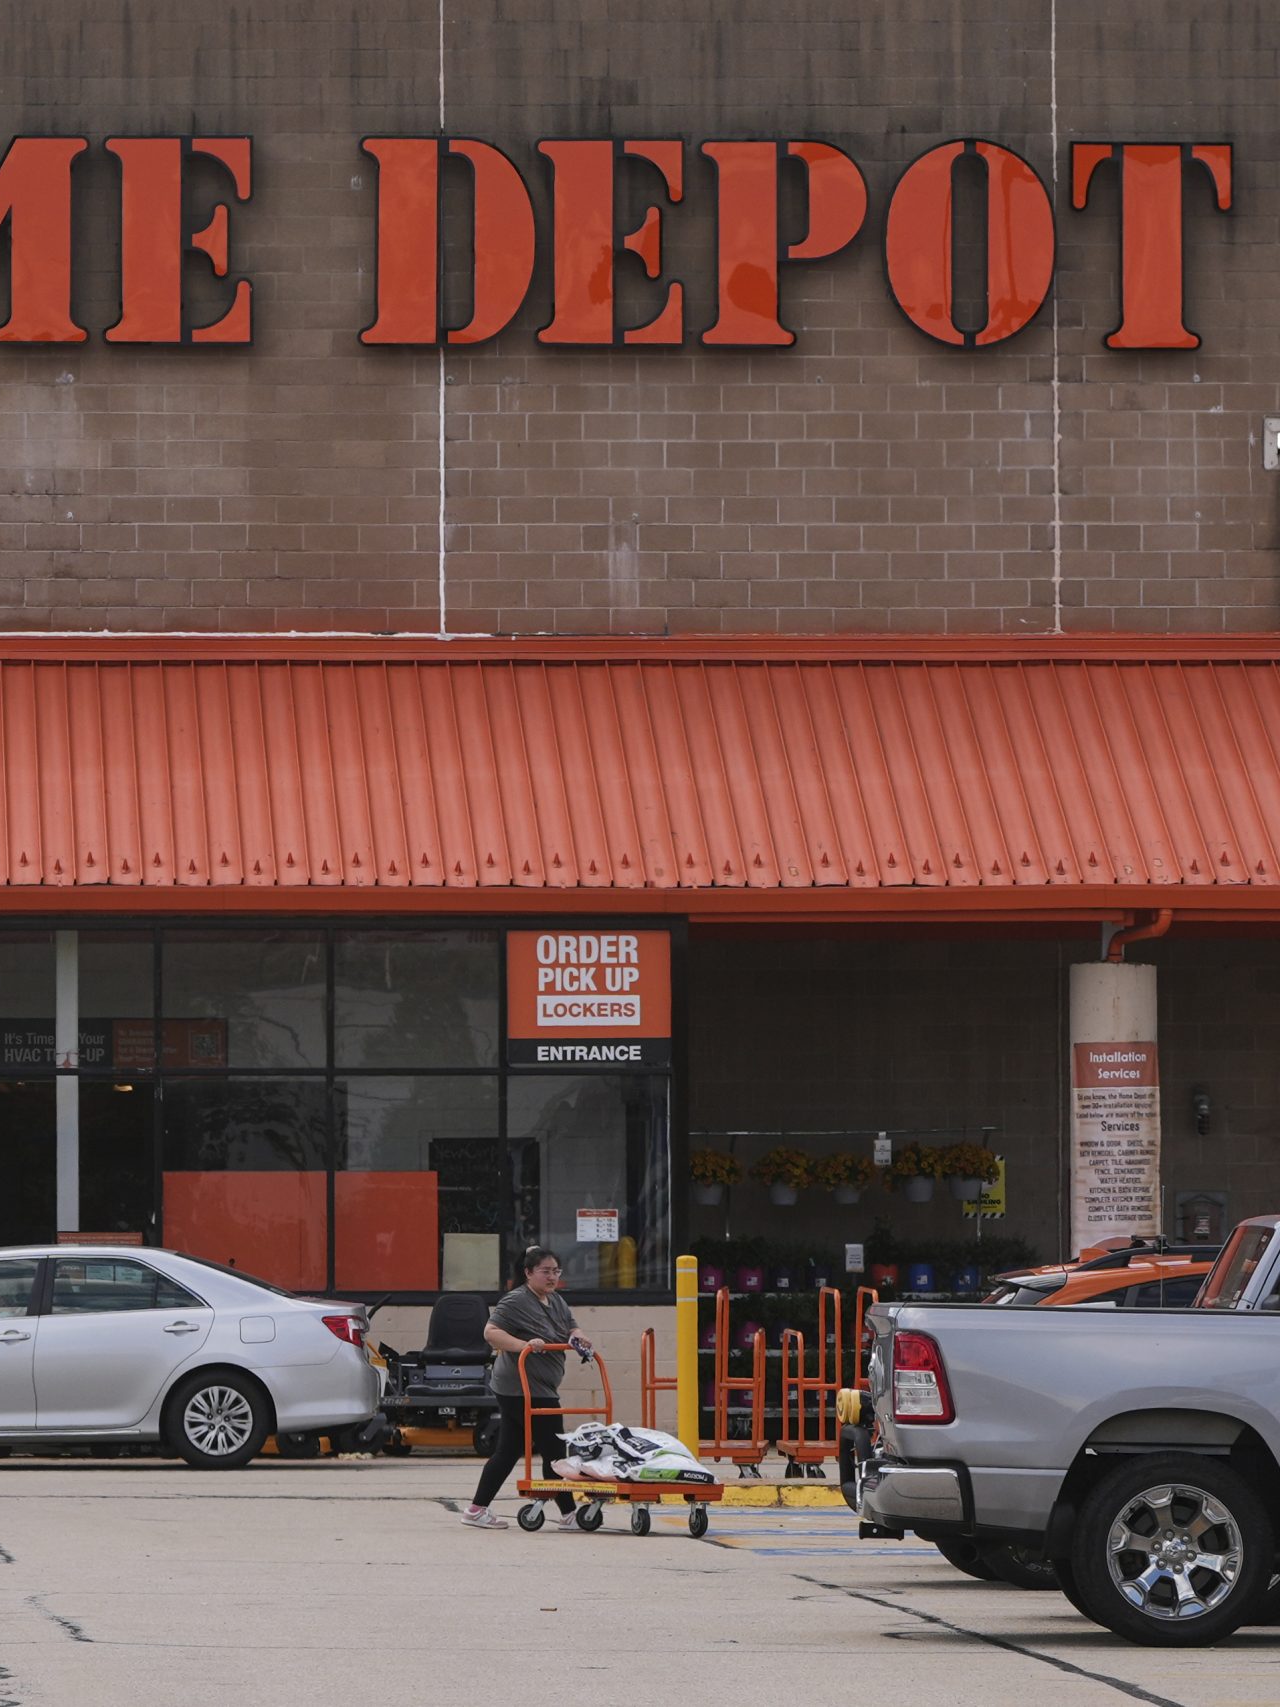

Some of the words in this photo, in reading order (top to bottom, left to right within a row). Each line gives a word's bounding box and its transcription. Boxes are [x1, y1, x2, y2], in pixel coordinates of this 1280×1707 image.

[358, 135, 1234, 352] DEPOT
[536, 935, 639, 964] ORDER
[538, 967, 597, 992] PICK
[605, 967, 640, 992] UP
[542, 1003, 636, 1018] LOCKERS
[4, 1032, 22, 1045] It's
[27, 1032, 56, 1045] Time
[4, 1048, 41, 1063] HVAC
[537, 1046, 642, 1062] ENTRANCE
[1089, 1051, 1147, 1063] Installation
[1098, 1068, 1140, 1080] Services
[1101, 1121, 1140, 1132] Services
